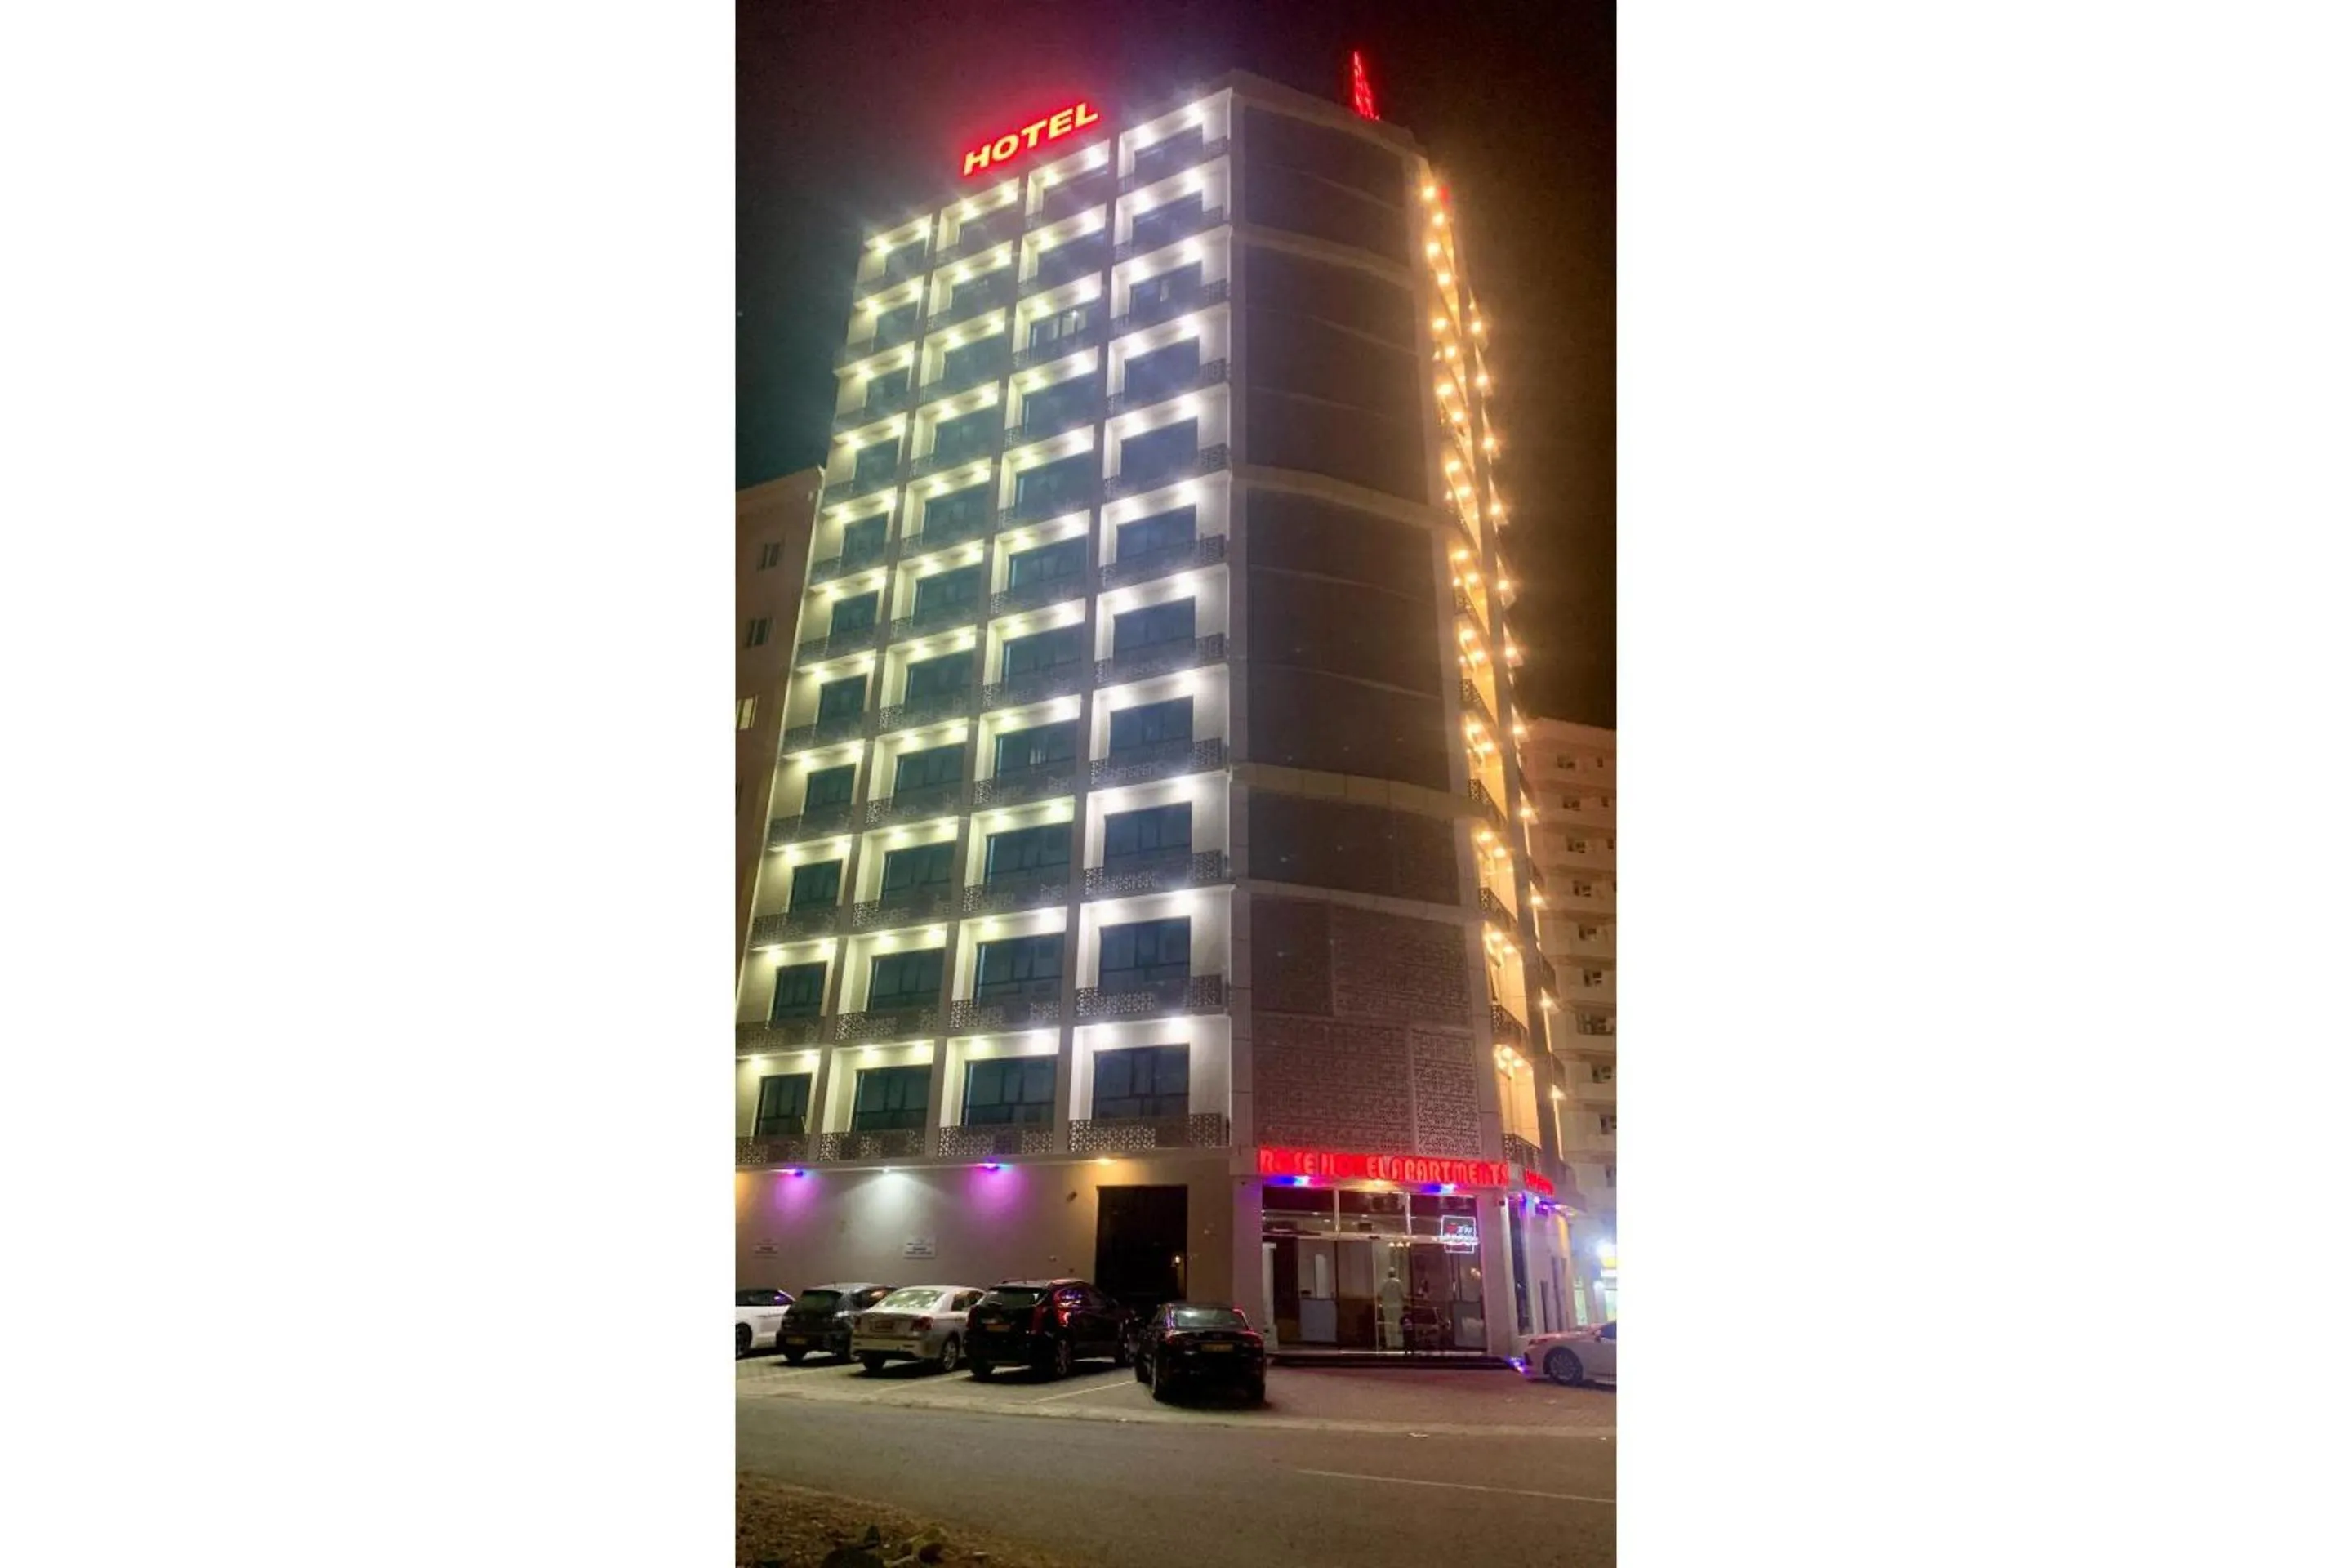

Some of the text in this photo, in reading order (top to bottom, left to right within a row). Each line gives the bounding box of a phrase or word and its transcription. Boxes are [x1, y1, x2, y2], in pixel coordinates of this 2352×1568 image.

[964, 102, 1098, 176] HOTEL
[1260, 1149, 1316, 1175] RSE
[1321, 1152, 1387, 1179] HEL
